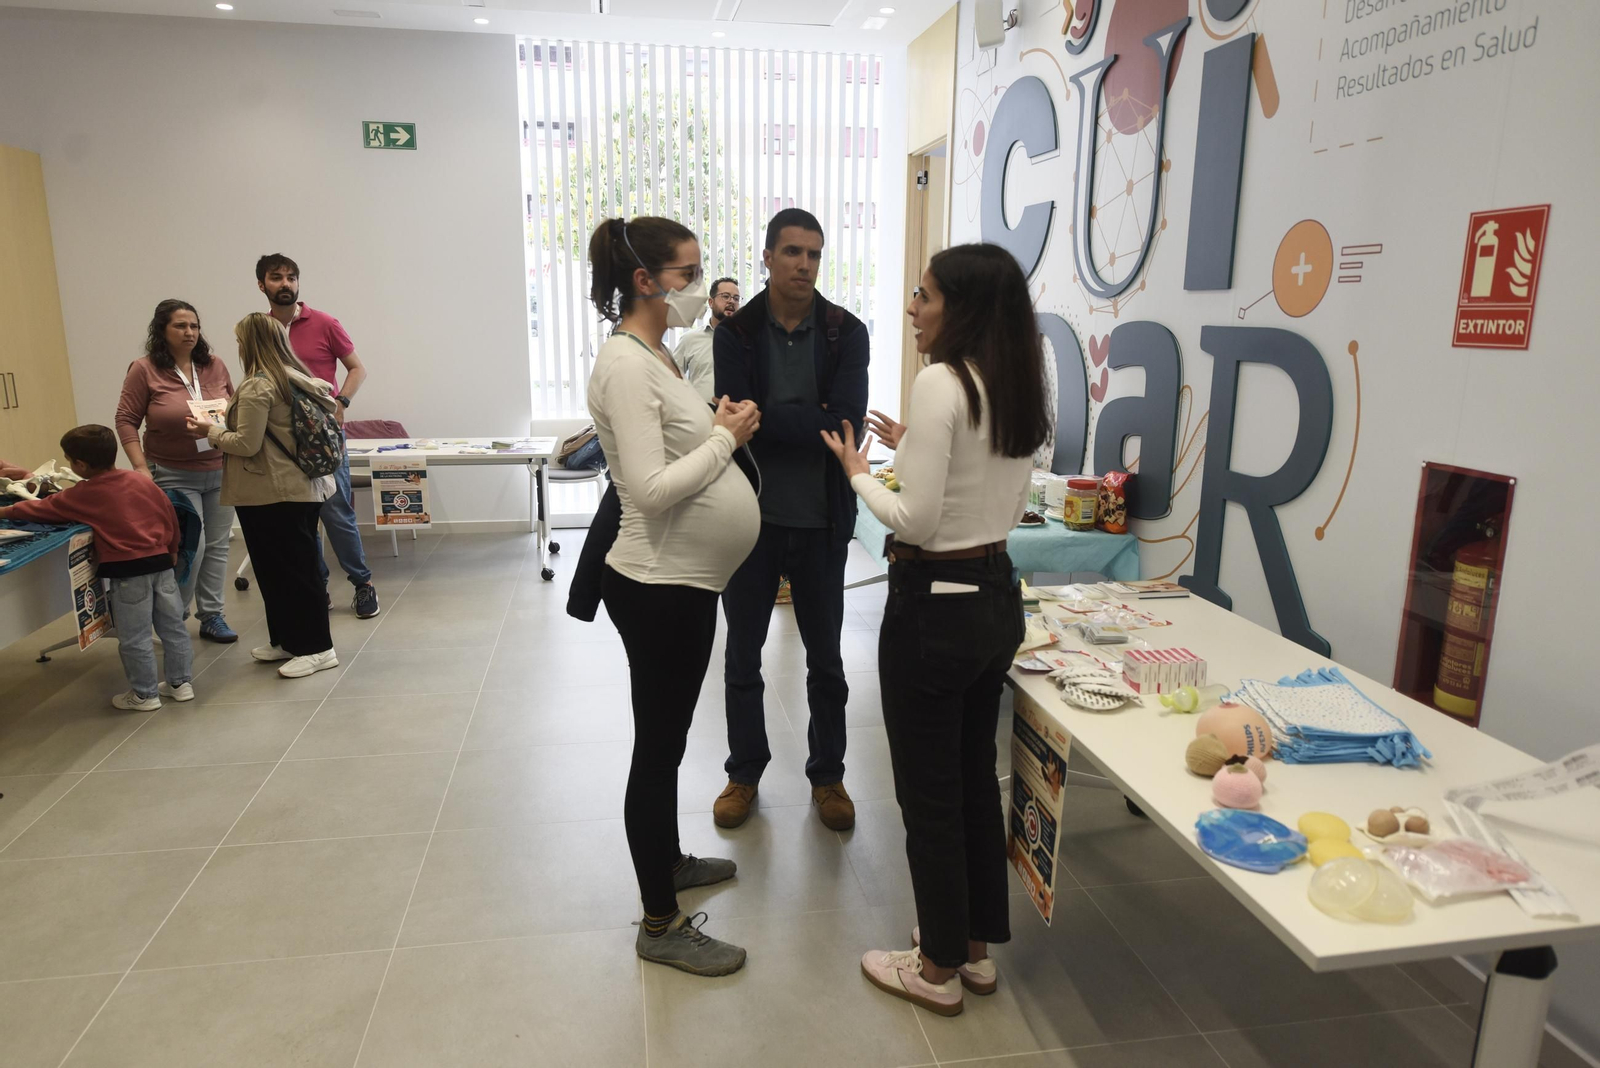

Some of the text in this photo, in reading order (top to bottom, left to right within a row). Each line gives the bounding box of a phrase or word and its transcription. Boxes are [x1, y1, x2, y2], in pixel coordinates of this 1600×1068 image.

[1345, 0, 1407, 24] Desa
[1339, 0, 1507, 63] Acompañamiento
[1336, 15, 1540, 100] Resultados en Salud
[1458, 319, 1526, 335] EXTINTOR
[1243, 724, 1255, 756] PHILIPS
